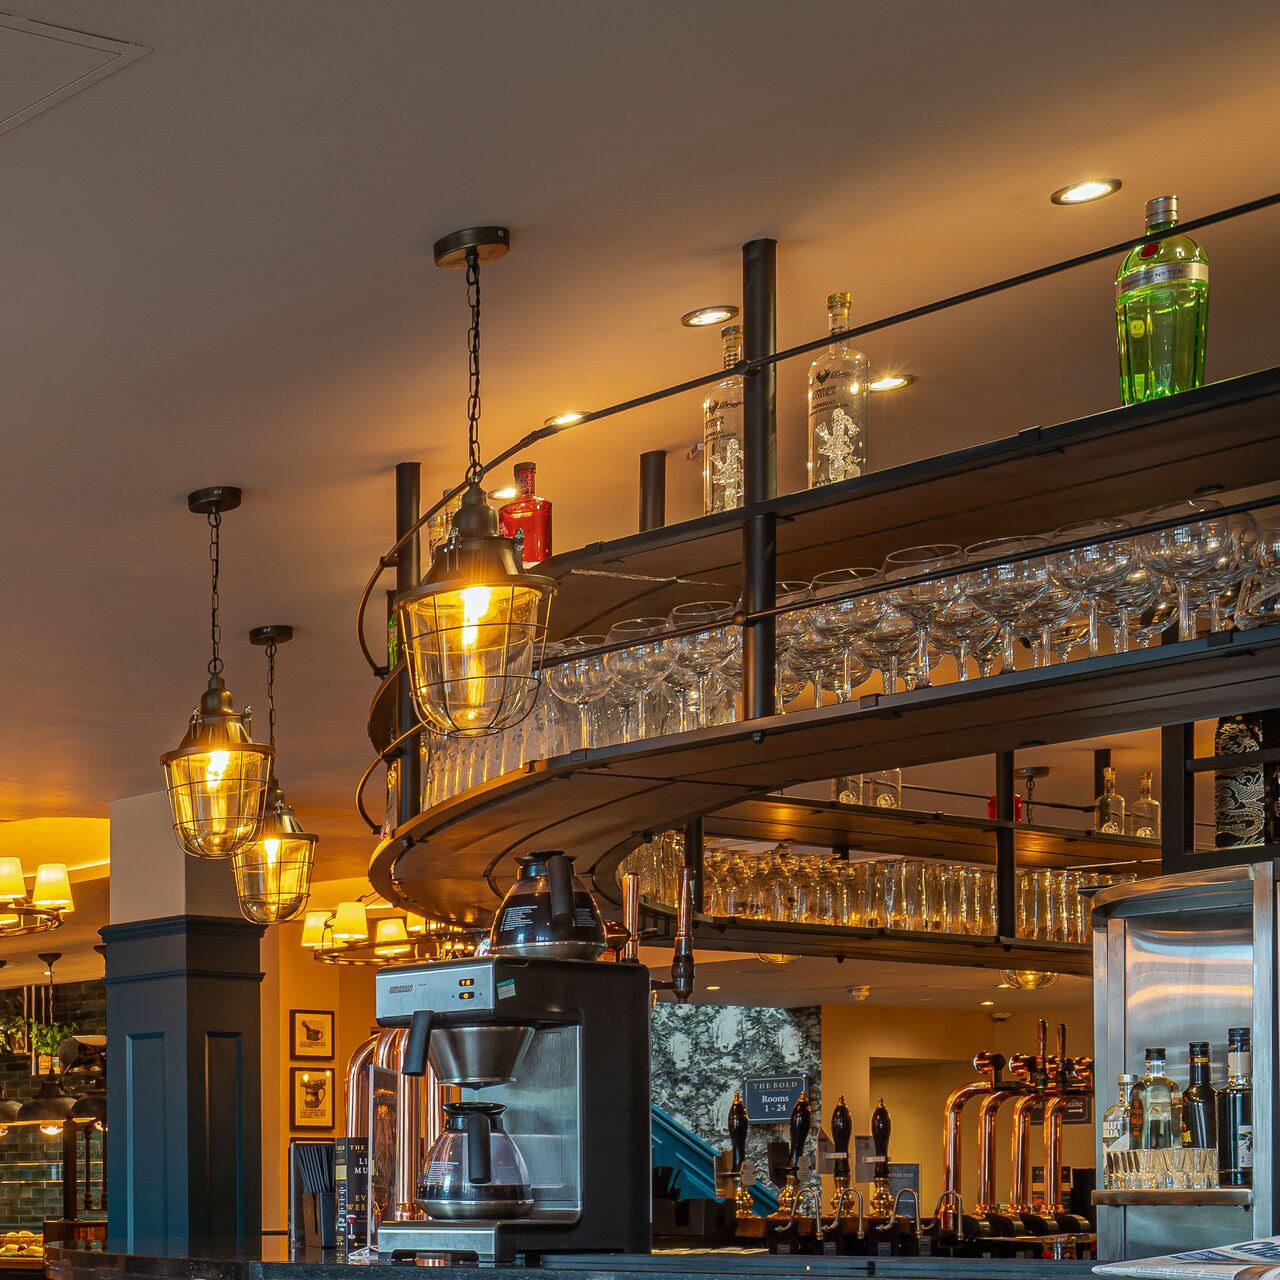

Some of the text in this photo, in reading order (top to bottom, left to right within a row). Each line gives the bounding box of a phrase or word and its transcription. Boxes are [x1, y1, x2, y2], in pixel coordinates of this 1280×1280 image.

[1169, 269, 1184, 277] TEN
[773, 1081, 798, 1089] BOLD
[761, 1095, 789, 1103] Rooms
[765, 1104, 769, 1112] 1
[776, 1104, 786, 1112] 24
